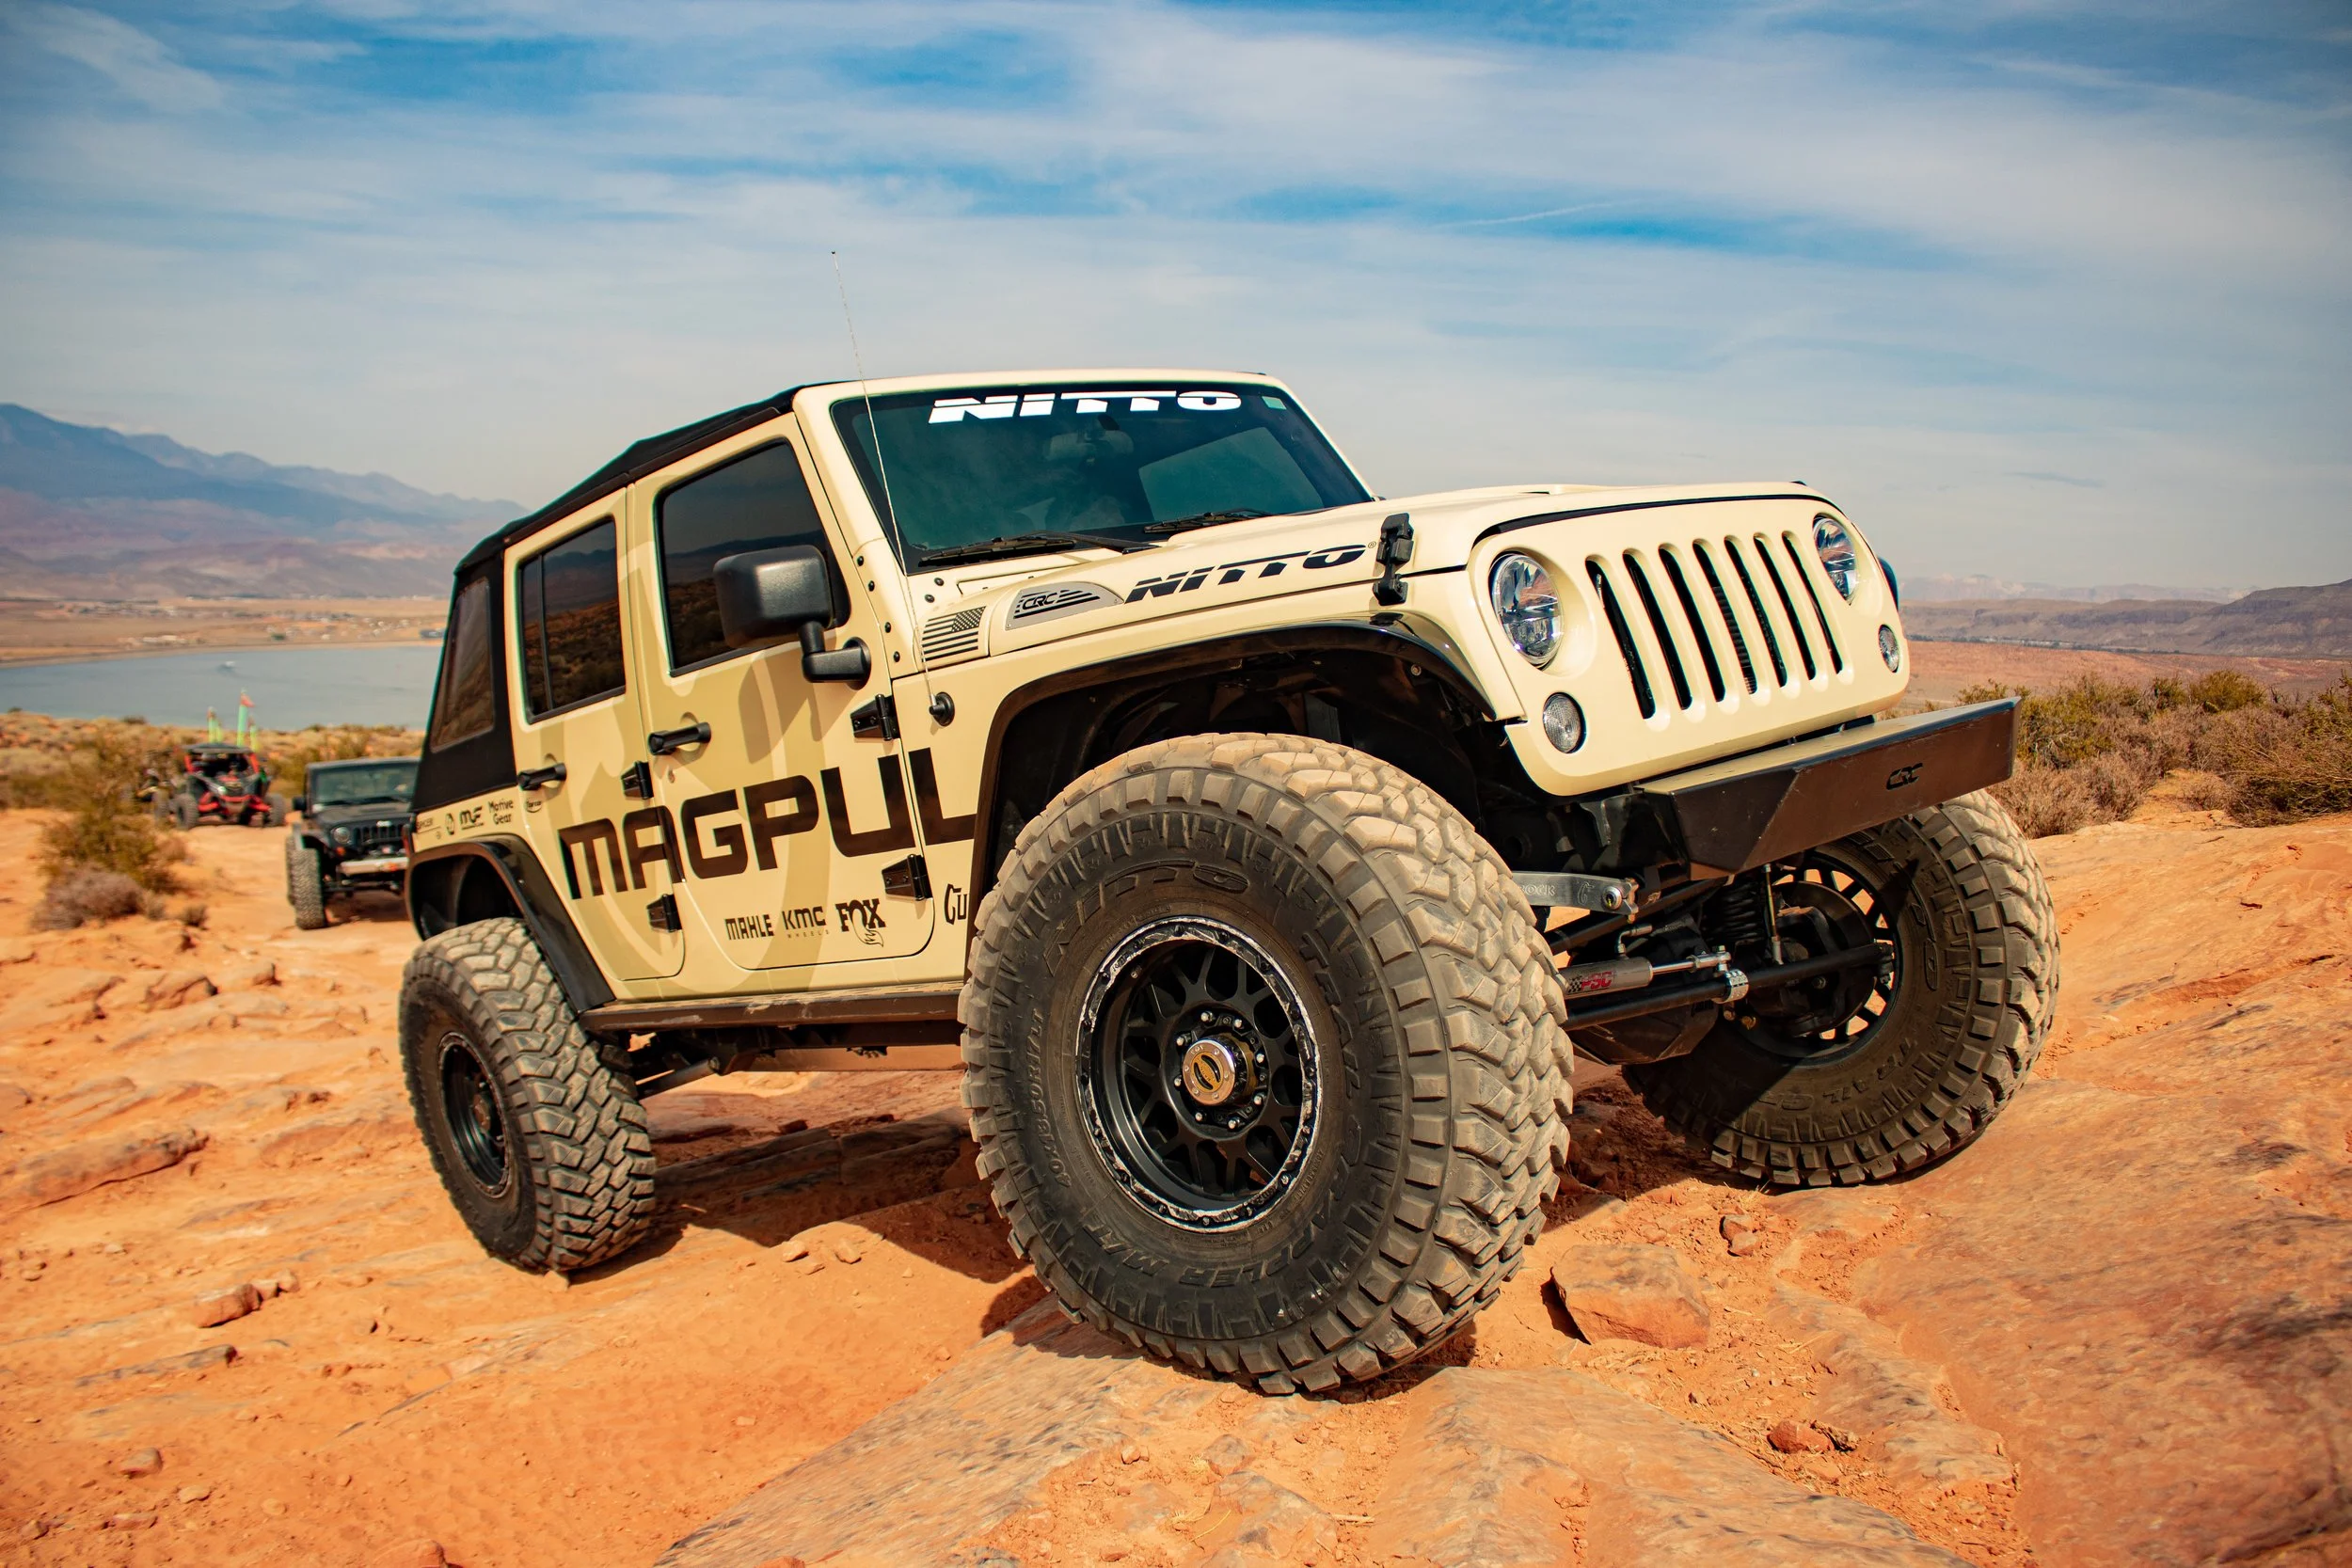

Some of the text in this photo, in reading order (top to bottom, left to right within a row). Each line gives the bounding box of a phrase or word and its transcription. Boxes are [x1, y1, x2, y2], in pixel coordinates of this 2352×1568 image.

[928, 389, 1242, 424] NITTO
[1124, 545, 1366, 605] NITTO
[488, 799, 515, 812] Motive
[492, 813, 513, 825] Gear
[557, 747, 978, 900] MAGPUL
[724, 914, 774, 941] MAHLE
[782, 906, 827, 930] KMC
[834, 898, 887, 933] FOX
